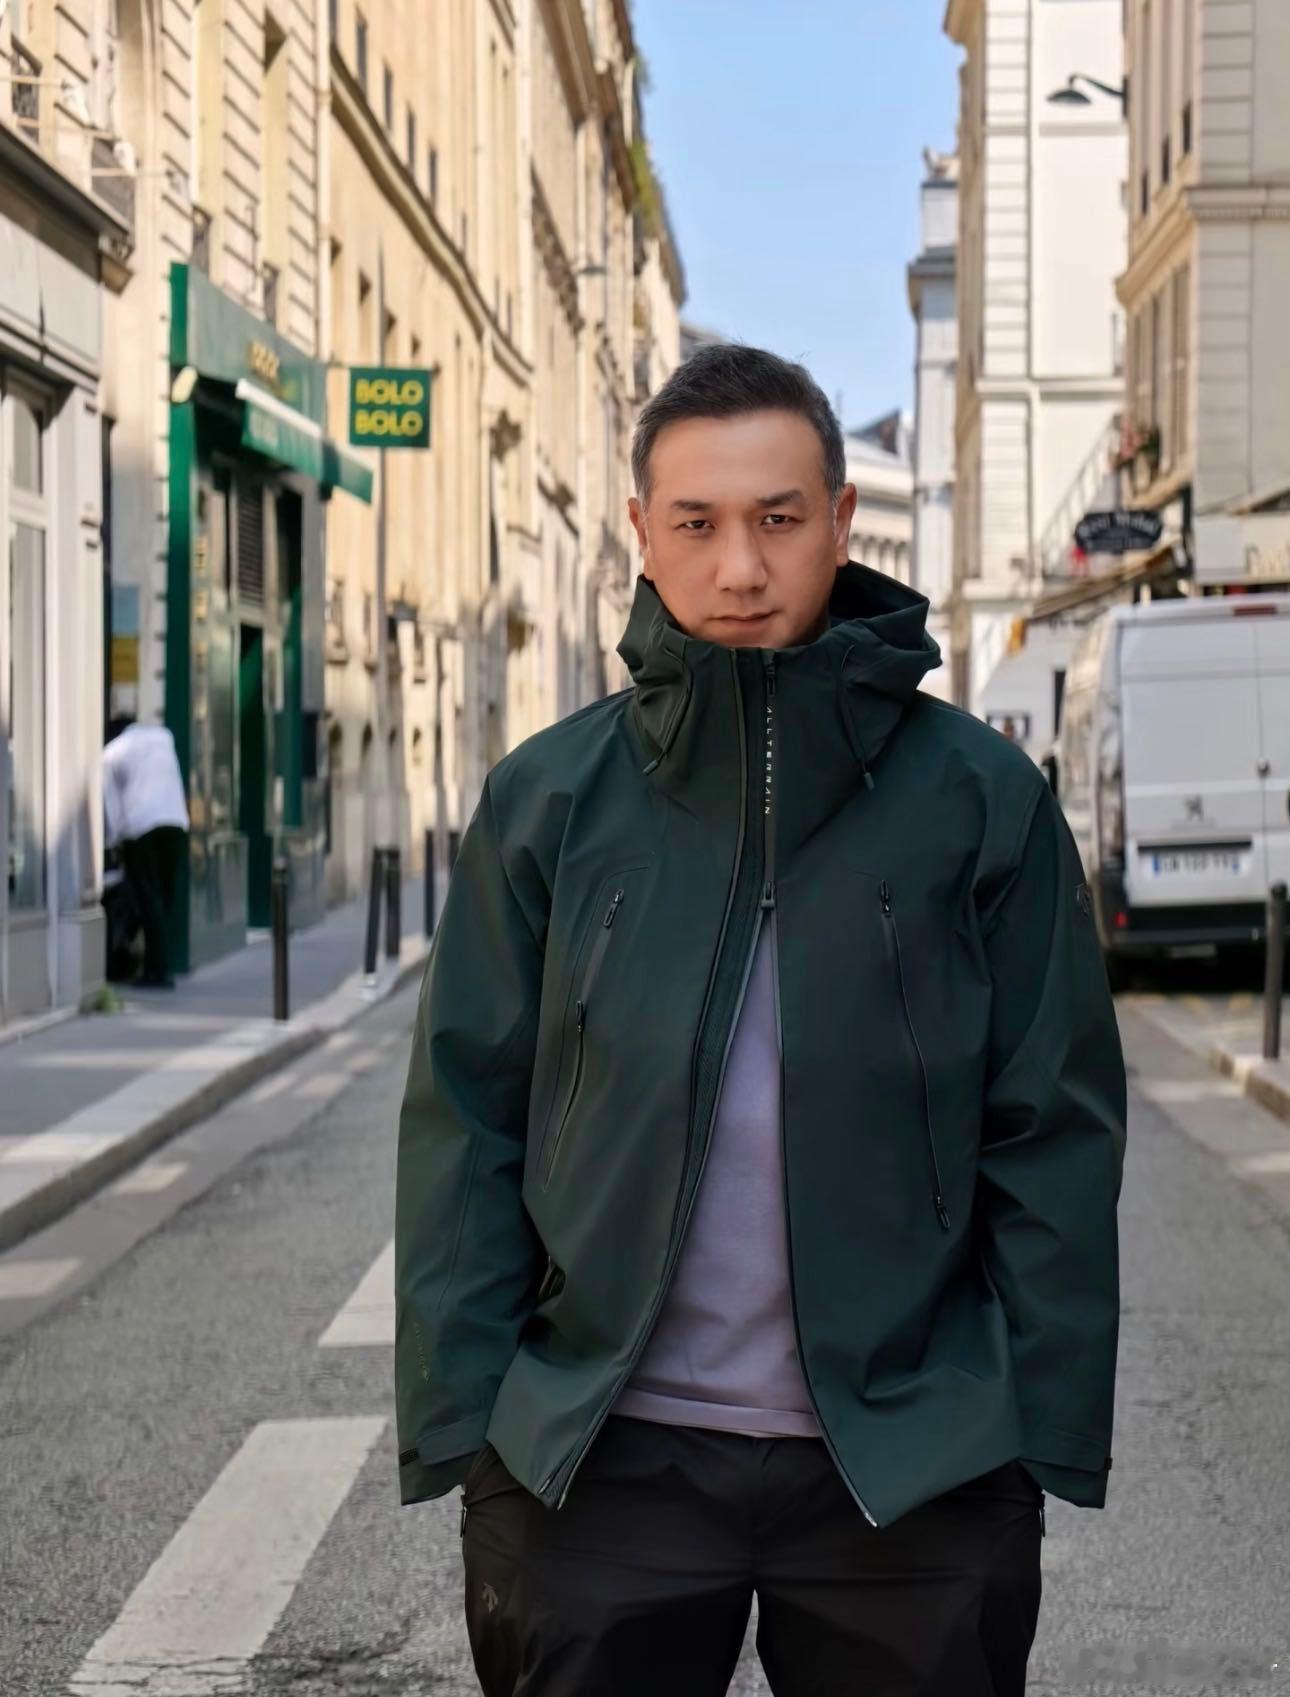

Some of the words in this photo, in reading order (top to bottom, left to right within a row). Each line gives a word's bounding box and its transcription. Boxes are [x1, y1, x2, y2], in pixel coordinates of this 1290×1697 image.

[355, 379, 424, 405] BOLO
[355, 410, 424, 437] BOLO
[765, 706, 773, 815] ALLTERRAIN
